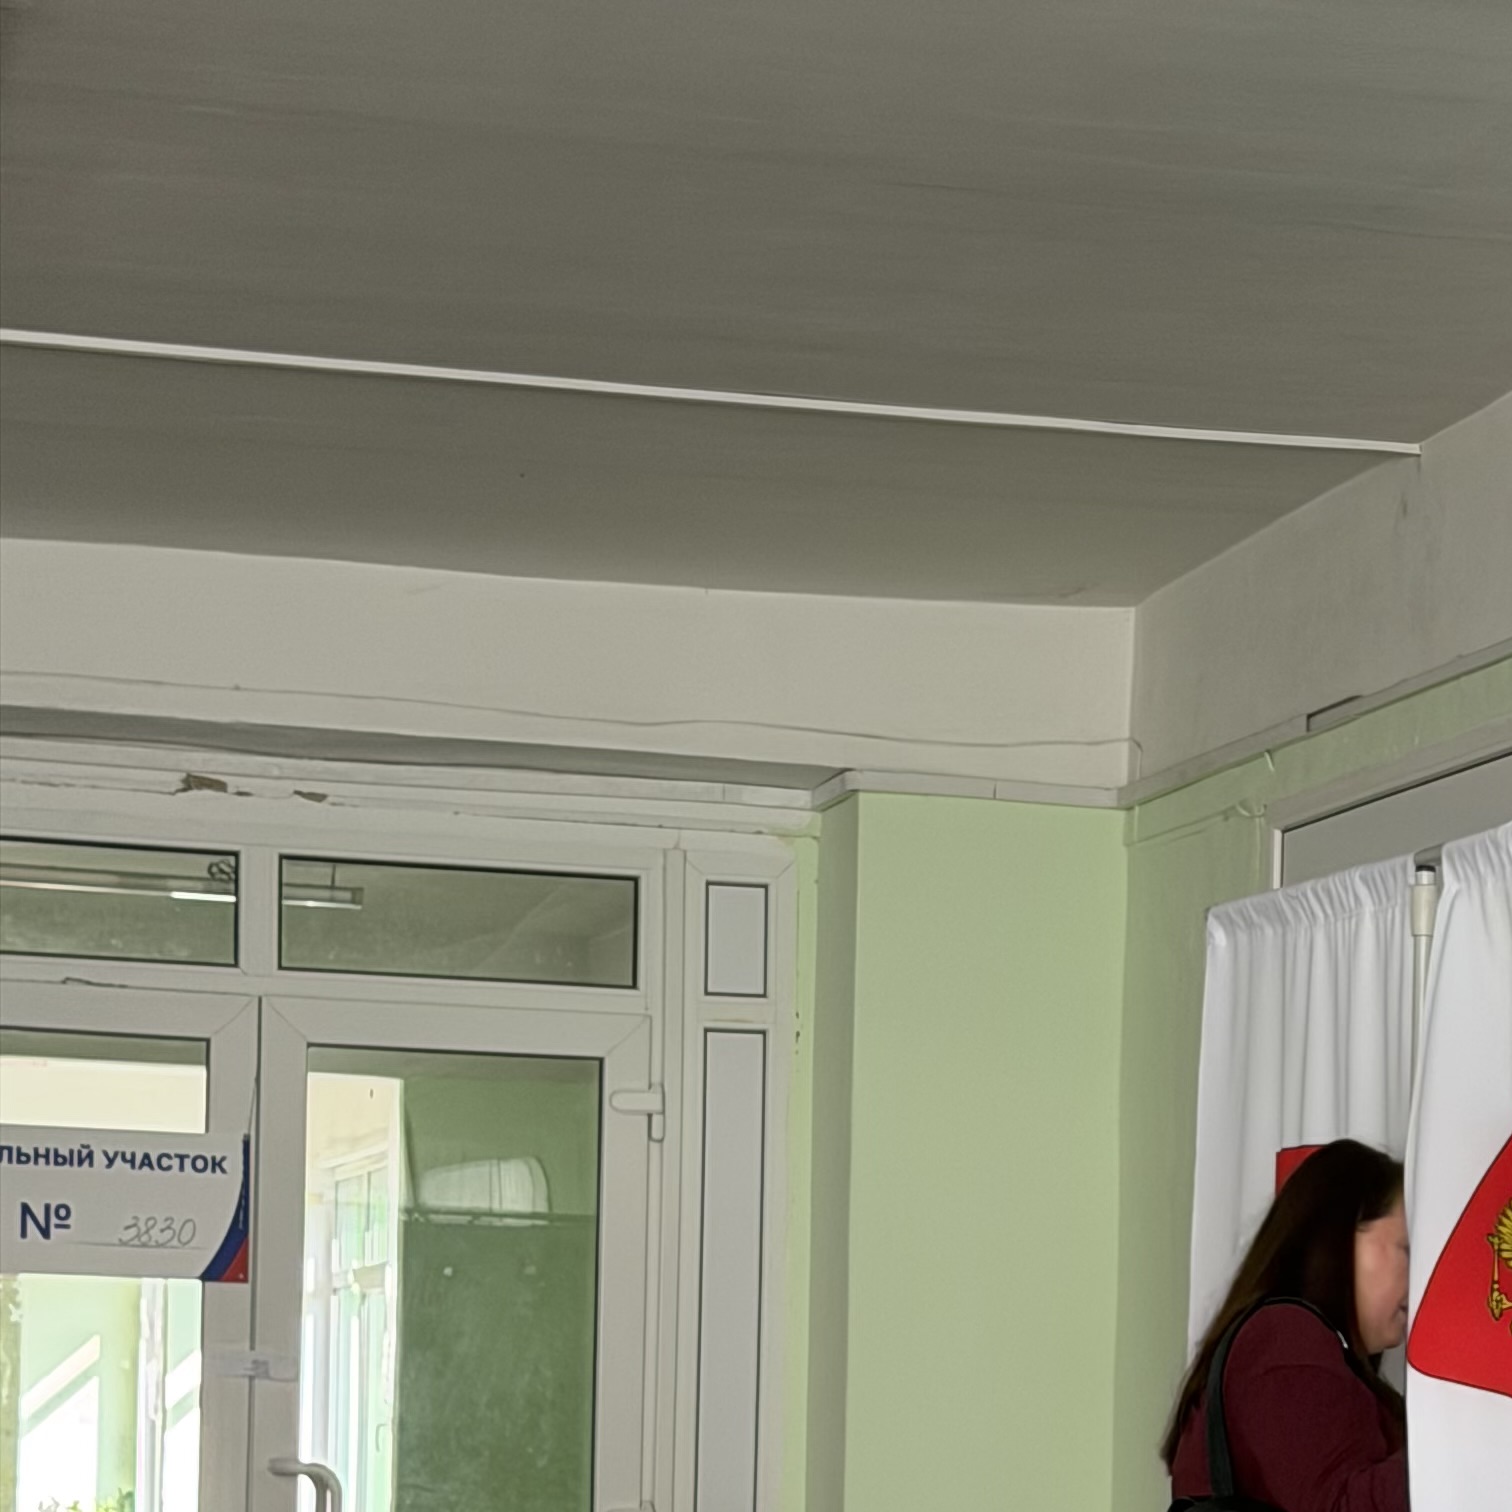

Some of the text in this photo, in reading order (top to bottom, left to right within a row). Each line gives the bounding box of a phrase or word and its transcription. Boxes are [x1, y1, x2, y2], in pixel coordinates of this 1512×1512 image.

[0, 1143, 228, 1174] ЛЬНЫЙ УЧАСТОК
[20, 1202, 71, 1240] №
[118, 1215, 196, 1247] 3830
